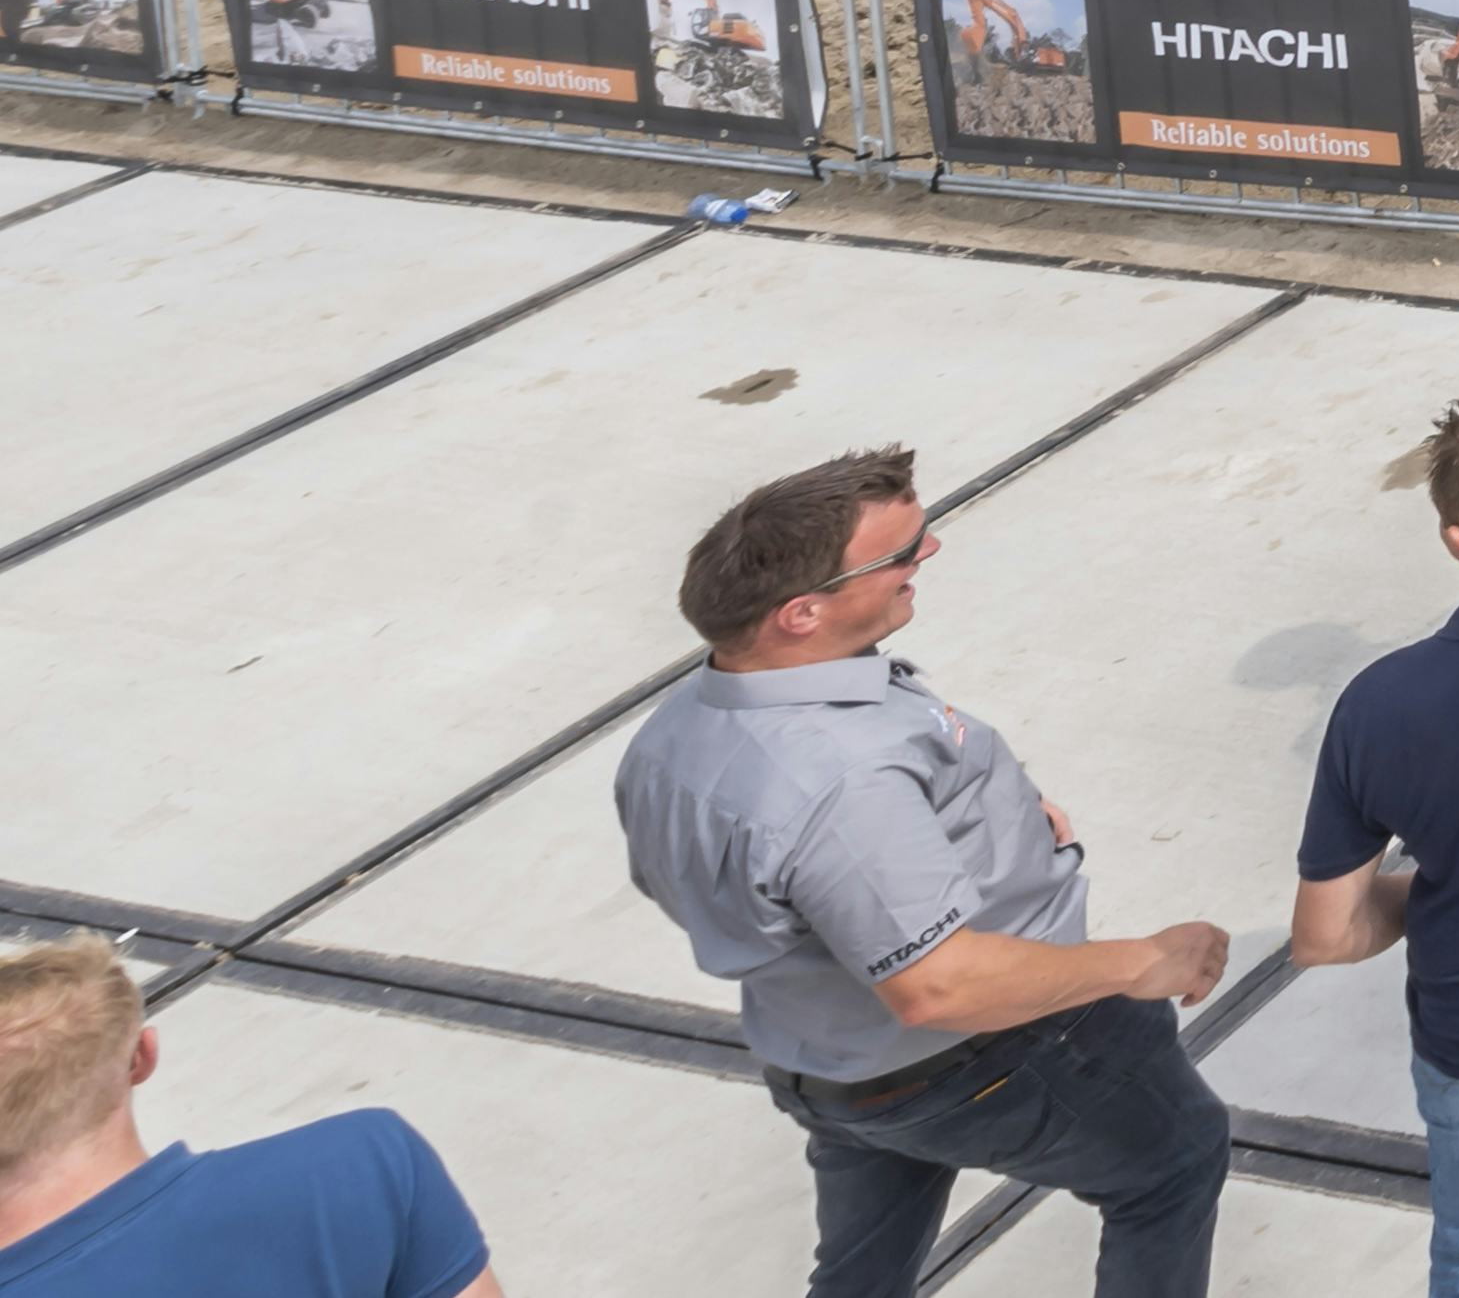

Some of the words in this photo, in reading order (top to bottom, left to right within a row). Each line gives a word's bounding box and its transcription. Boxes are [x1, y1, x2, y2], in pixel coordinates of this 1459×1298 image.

[1151, 21, 1349, 71] HITACHI
[420, 52, 506, 84] Reliable
[512, 63, 612, 95] solutions
[1151, 117, 1248, 150] Reliable
[1256, 129, 1371, 159] solutions
[867, 906, 962, 977] HITACHI
